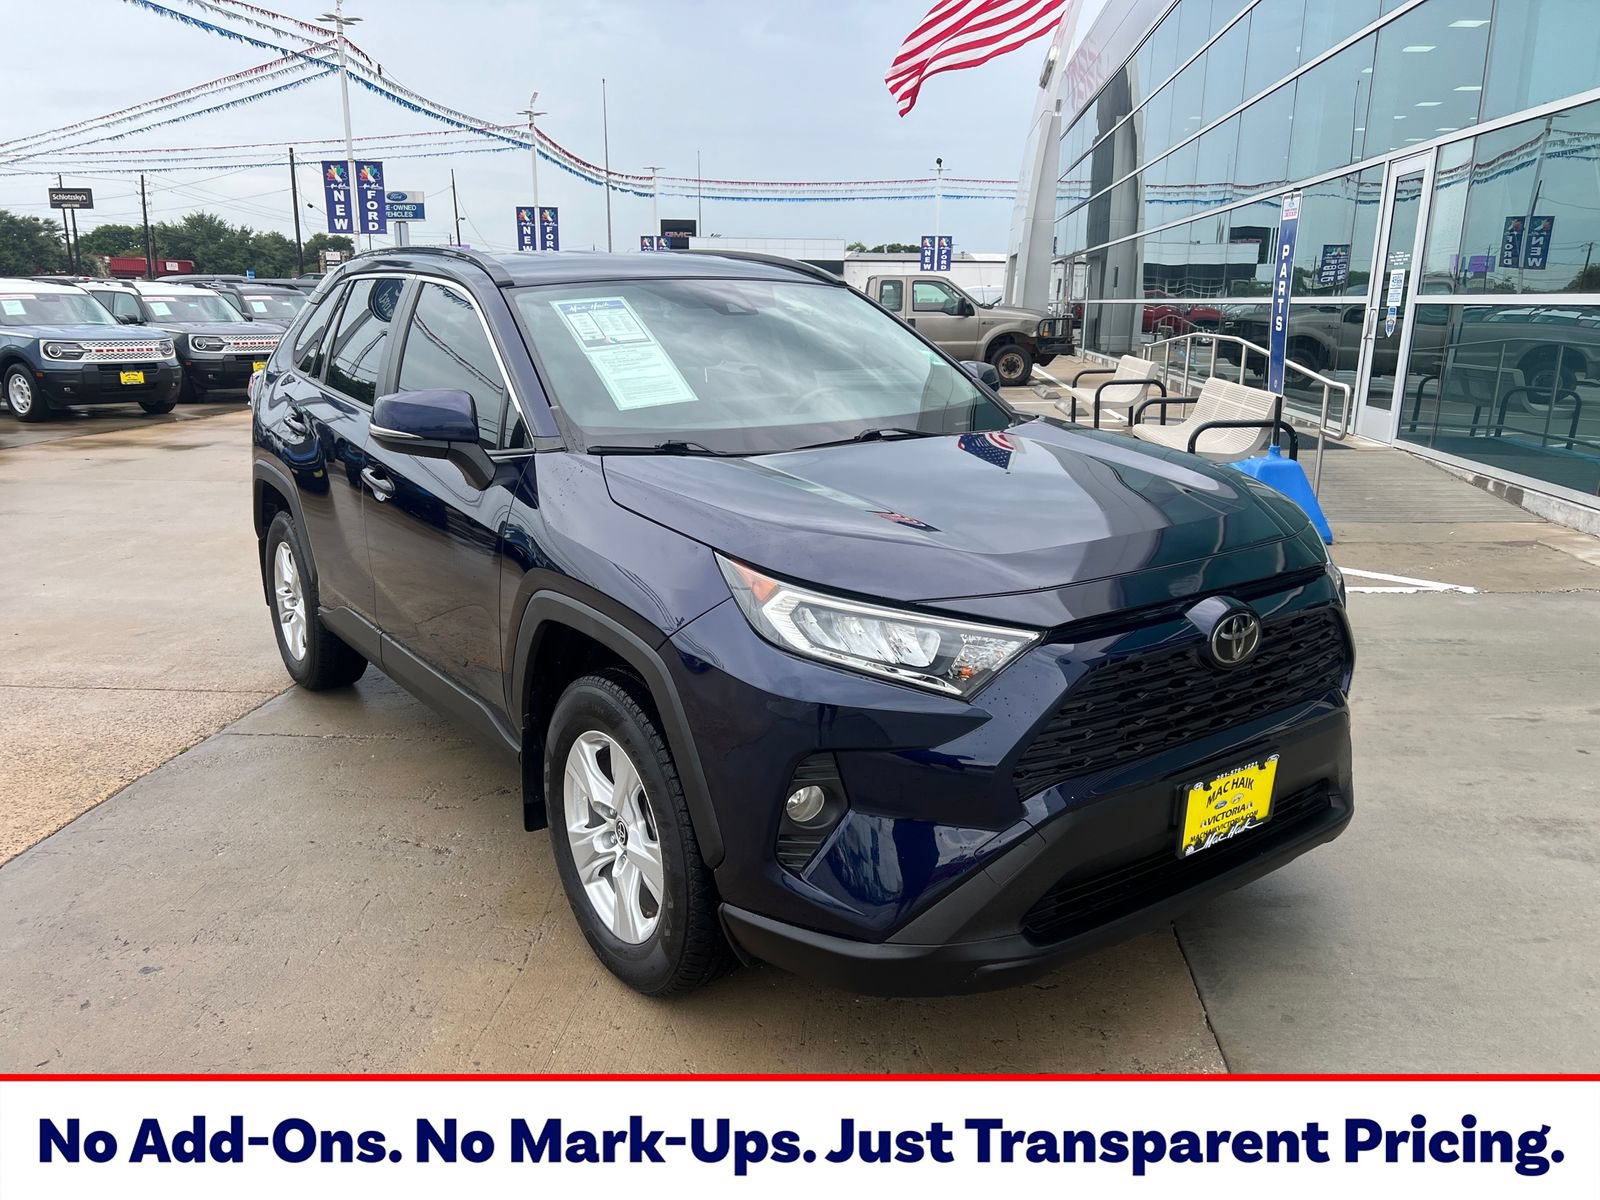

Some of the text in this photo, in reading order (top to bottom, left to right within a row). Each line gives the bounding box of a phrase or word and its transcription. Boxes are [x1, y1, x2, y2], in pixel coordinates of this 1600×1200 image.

[333, 190, 349, 231] NEW
[366, 190, 379, 231] FORD
[923, 250, 932, 270] NEW
[940, 249, 948, 270] FORD
[1275, 244, 1290, 332] PARTS
[1206, 781, 1231, 808] MAC
[1231, 776, 1254, 791] HAIK
[1207, 803, 1246, 826] VICTORIA
